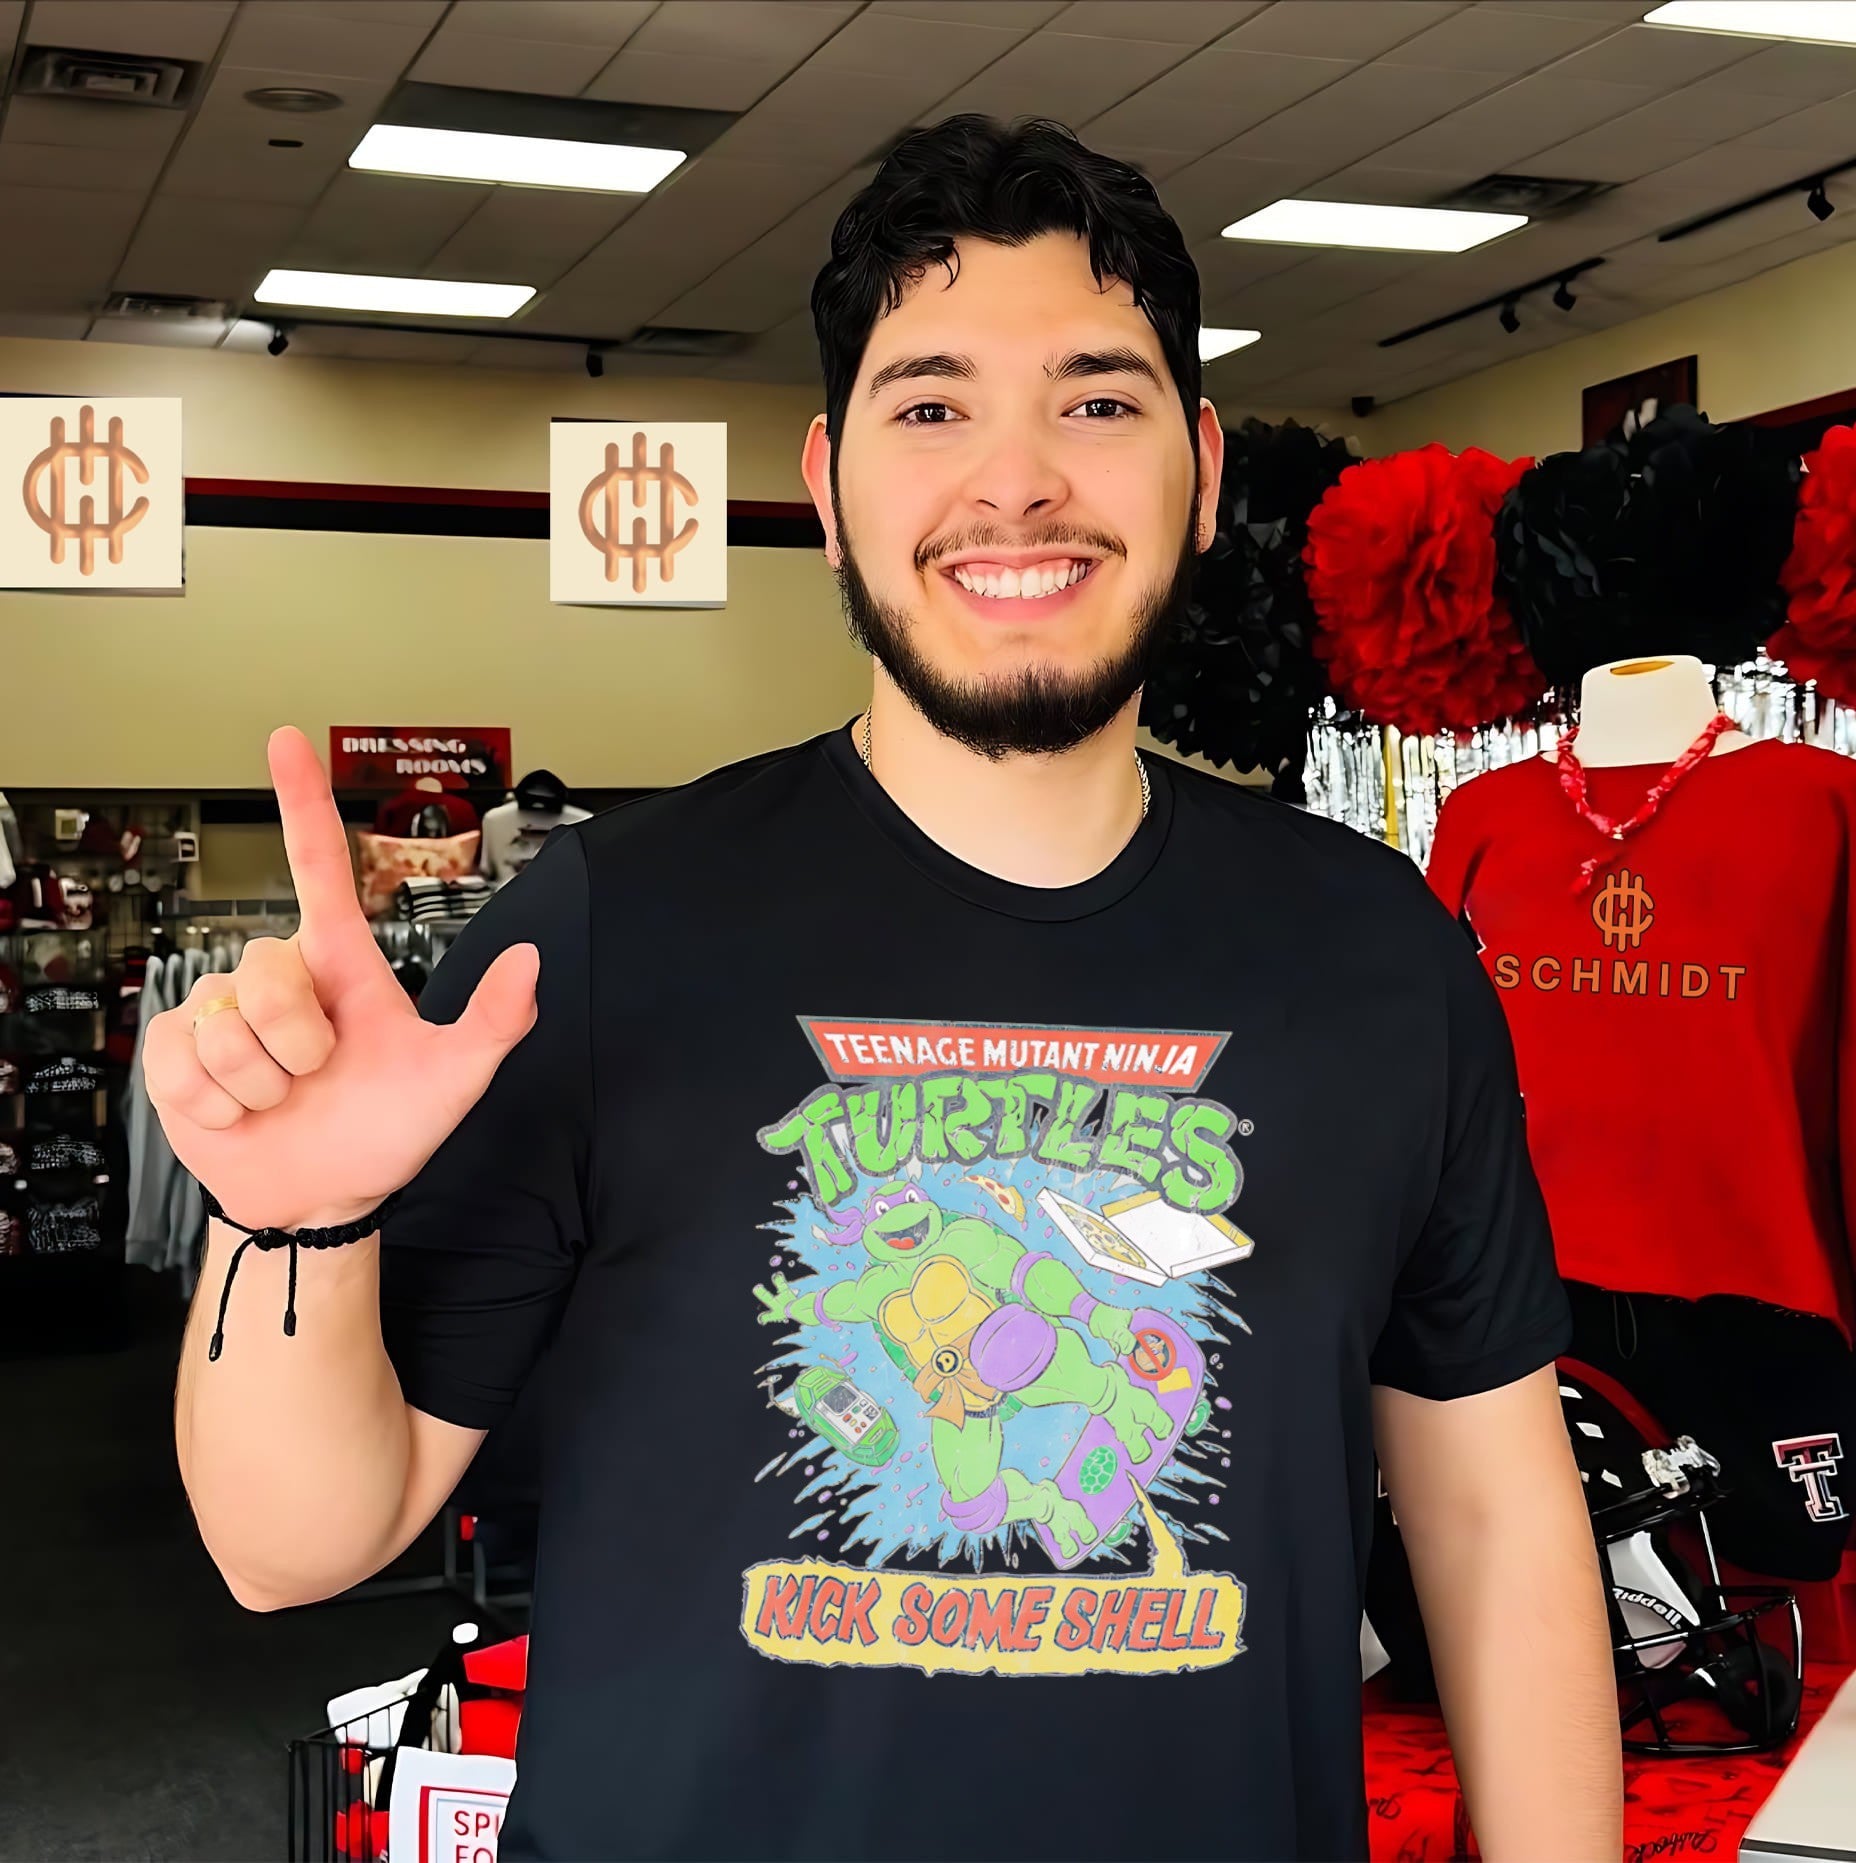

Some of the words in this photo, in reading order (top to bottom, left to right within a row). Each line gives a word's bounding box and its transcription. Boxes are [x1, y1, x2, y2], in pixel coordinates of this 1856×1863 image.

[1494, 954, 1747, 1000] SCHMIDT
[823, 1032, 976, 1067] TEENAGE
[982, 1037, 1100, 1071] MUTANT
[1101, 1043, 1199, 1077] NINJA
[757, 1072, 1244, 1216] TURTLES
[755, 1573, 882, 1648] KICK
[892, 1581, 1055, 1653] SOME
[1053, 1586, 1226, 1653] SHELL
